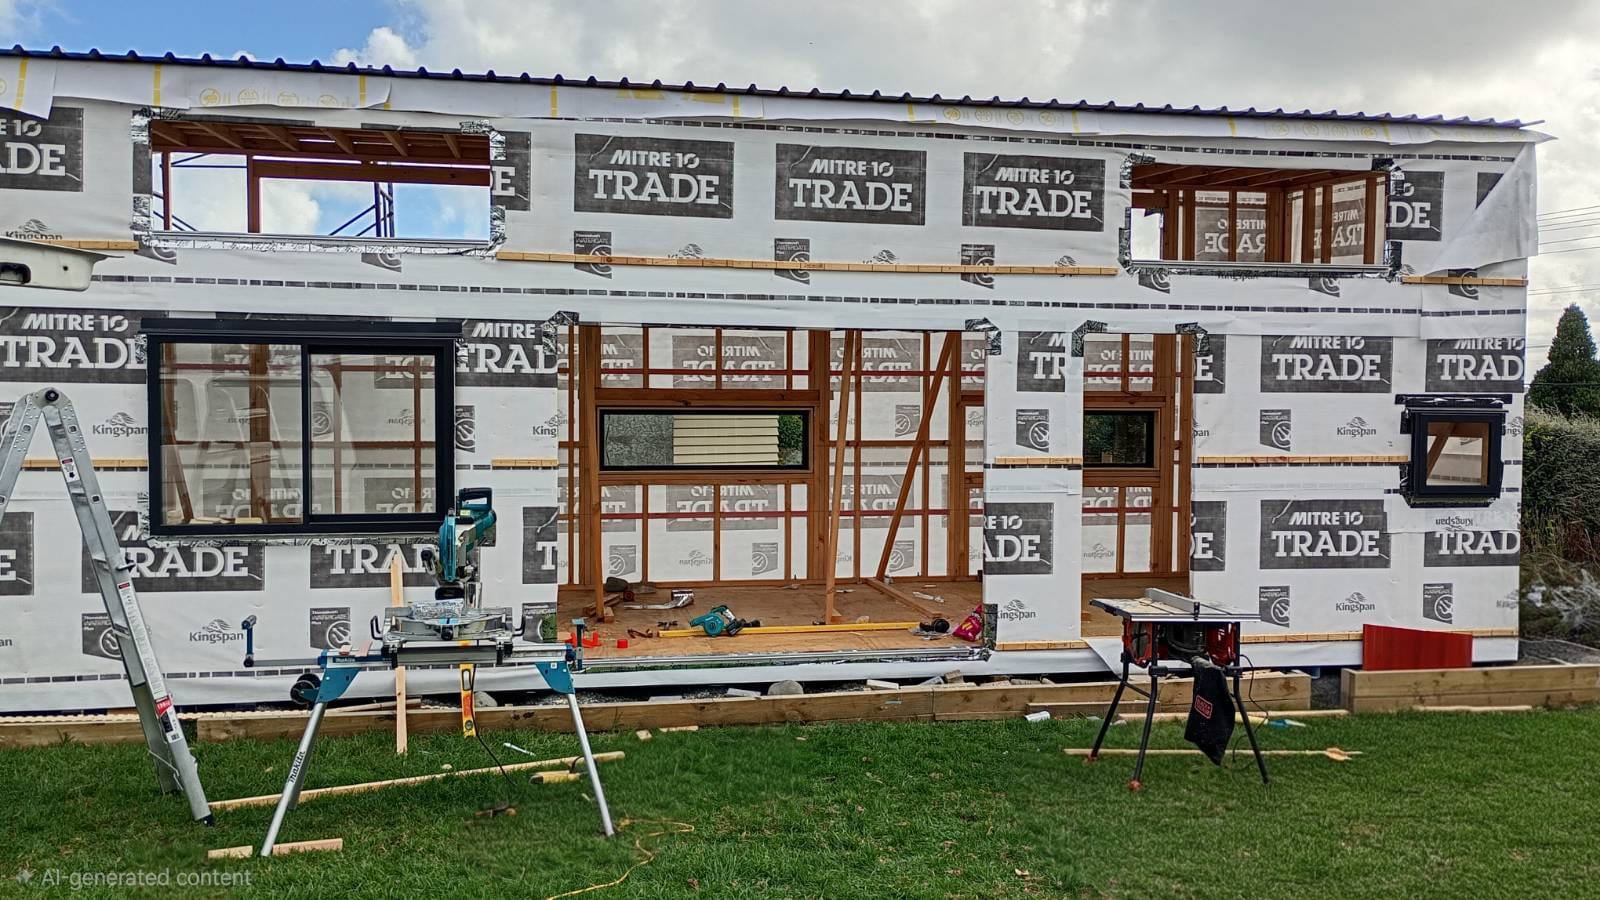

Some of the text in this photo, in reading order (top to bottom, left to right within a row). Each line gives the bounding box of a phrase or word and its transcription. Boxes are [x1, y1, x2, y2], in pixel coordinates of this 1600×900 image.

[12, 119, 42, 137] 10
[610, 149, 700, 169] MITRE 10
[809, 158, 894, 177] MITRE 10
[994, 166, 1075, 185] MITRE 10
[588, 168, 720, 205] TRADE
[788, 178, 913, 212] TRADE
[973, 185, 1092, 219] TRADE
[21, 313, 129, 331] MITRE 10
[472, 322, 536, 338] MITRE
[1289, 336, 1365, 350] MITRE 10
[1454, 338, 1524, 350] MITRE 10
[456, 343, 557, 373] TRAD
[1271, 354, 1381, 381] TRADE
[1436, 354, 1524, 381] TRAD
[92, 424, 148, 438] Kingspan
[532, 425, 557, 438] King
[1336, 426, 1377, 438] Kingspan
[997, 515, 1023, 530] 10
[1288, 511, 1364, 526] MITRE 10
[1435, 515, 1474, 526] Kingspan
[1271, 530, 1380, 557] TRADE
[1435, 531, 1521, 555] TRAD
[120, 546, 249, 578] RADE
[325, 544, 438, 575] TRAD
[1335, 601, 1376, 613] Kingspan
[189, 631, 244, 644] Kingspan
[289, 750, 306, 784] makita
